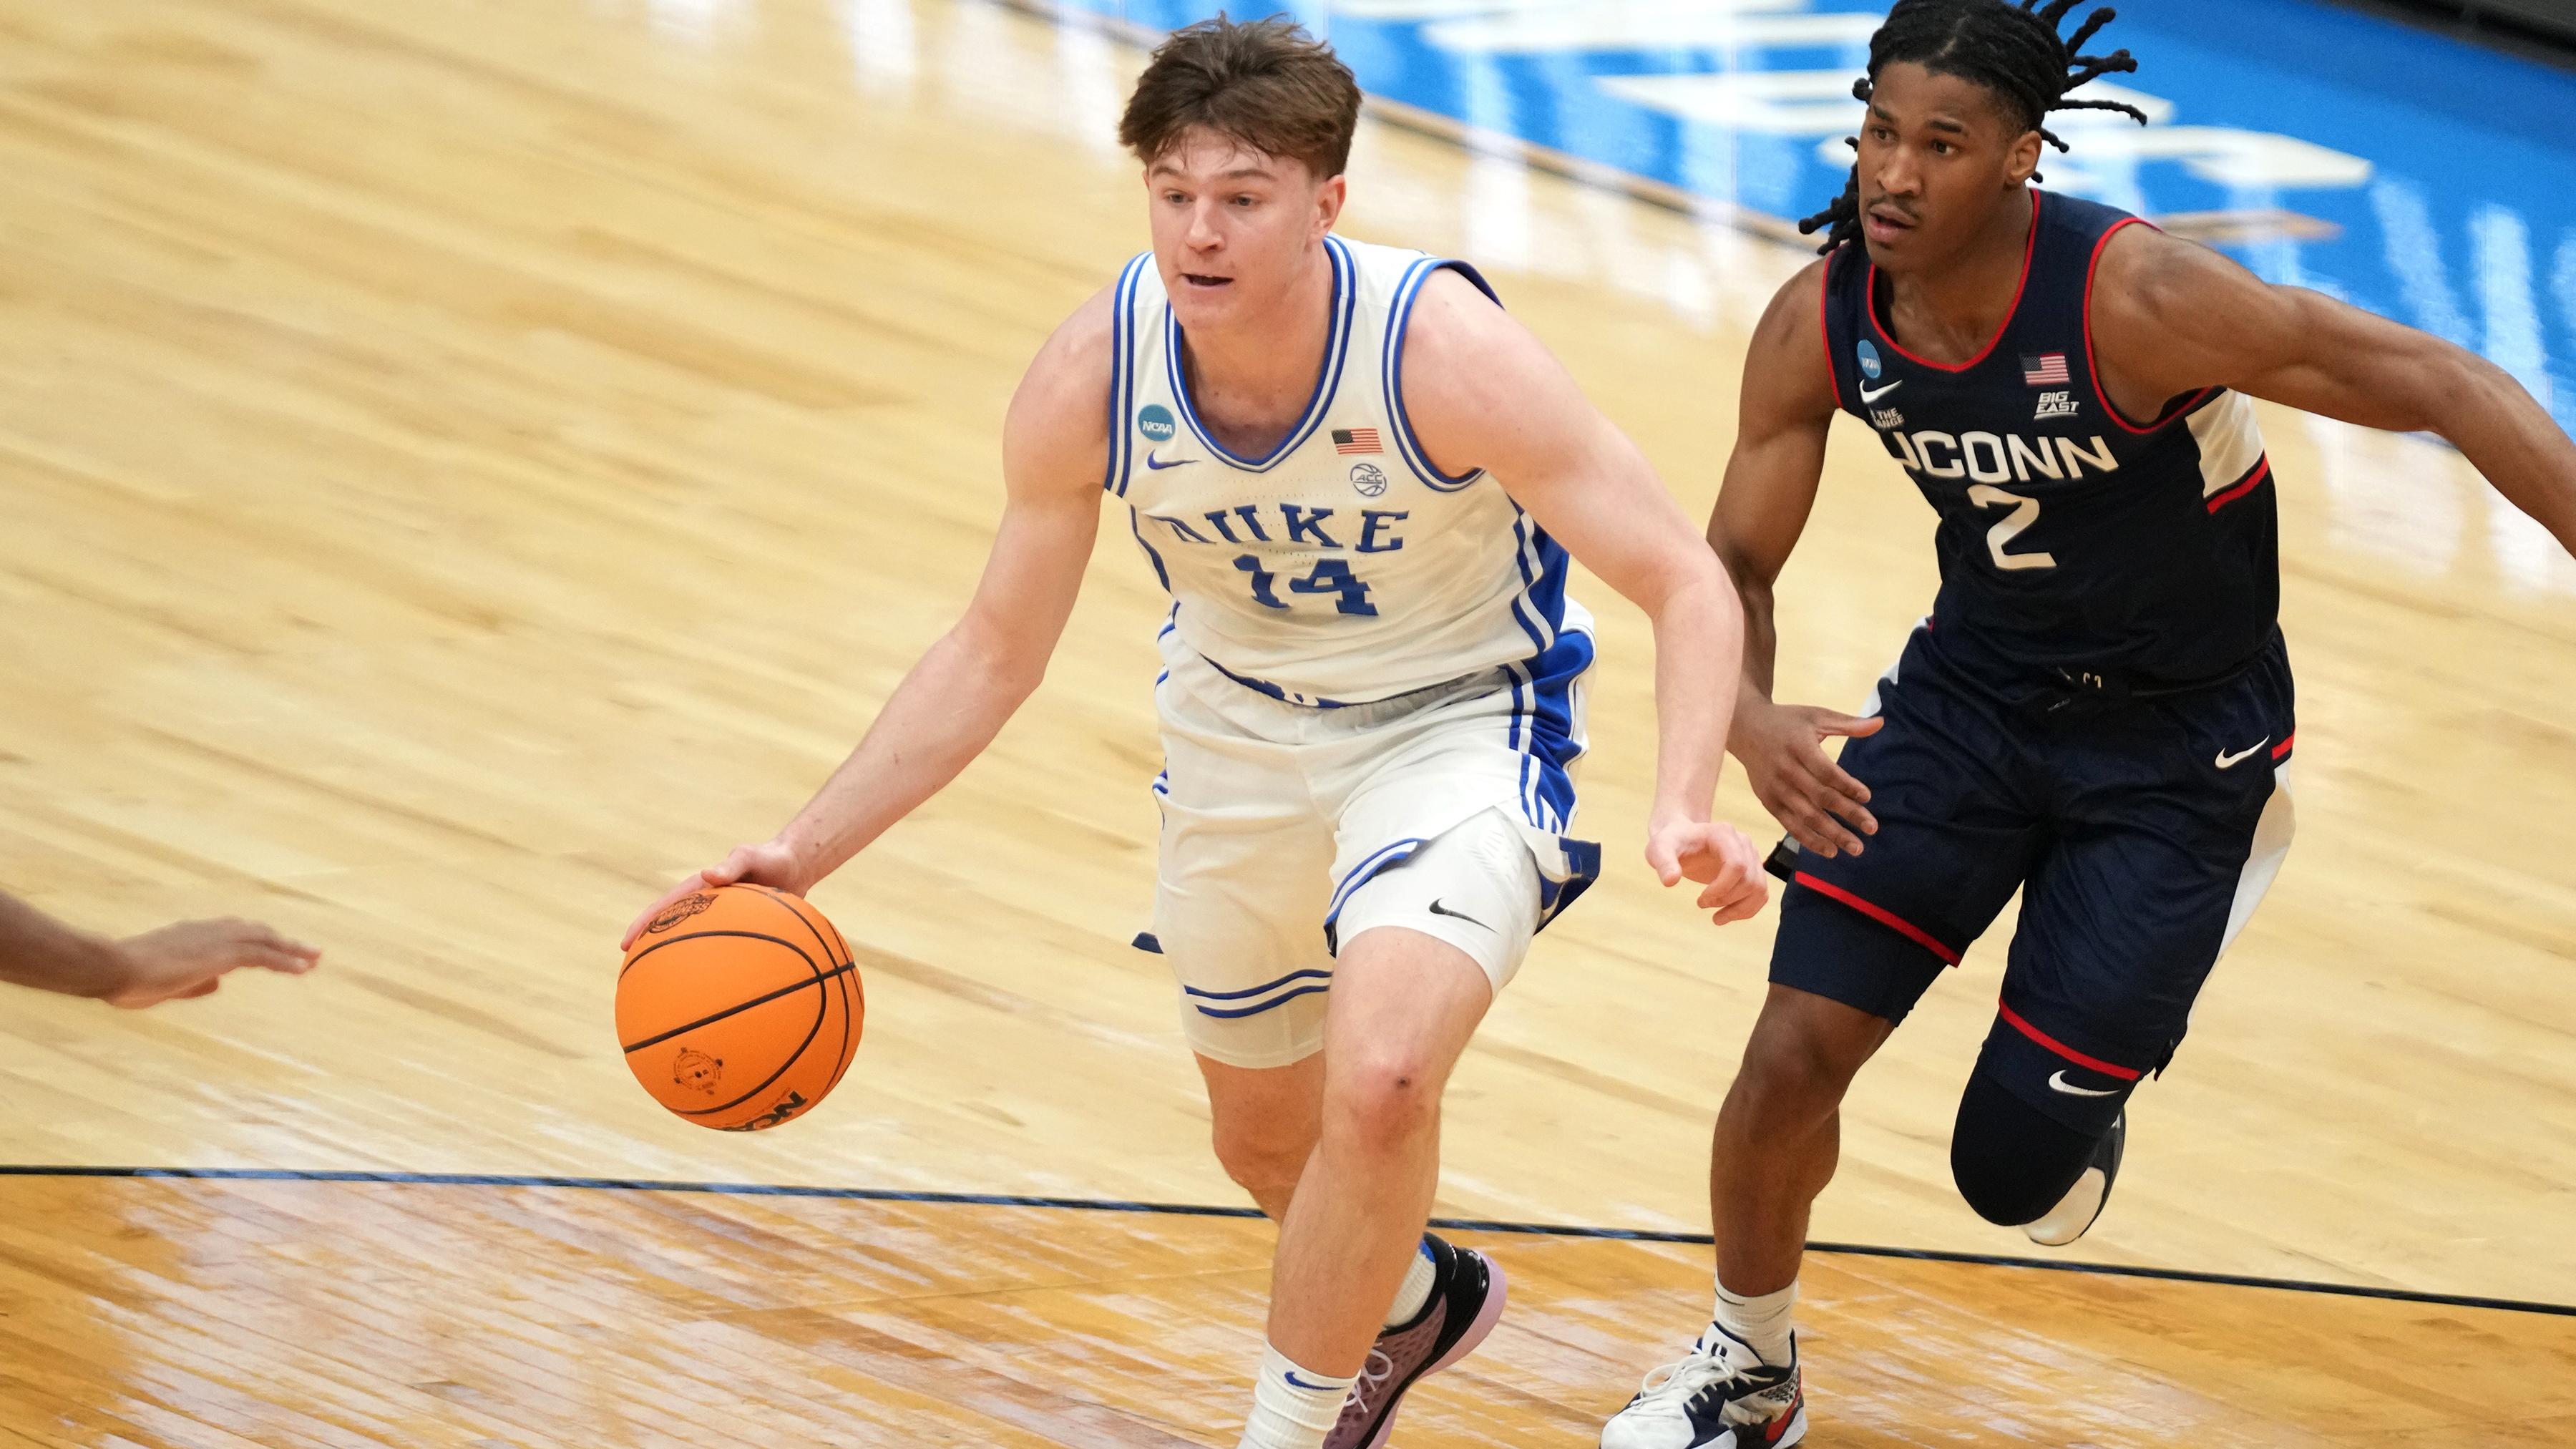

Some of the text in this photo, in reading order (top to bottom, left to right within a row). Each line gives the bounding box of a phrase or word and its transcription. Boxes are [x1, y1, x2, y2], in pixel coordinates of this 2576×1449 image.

[2038, 391, 2070, 403] BIG
[2035, 401, 2079, 413] EAST
[1142, 420, 1173, 434] NCAA
[1356, 474, 1383, 482] ACC
[1967, 484, 2057, 570] 2
[1233, 553, 1379, 616] 14
